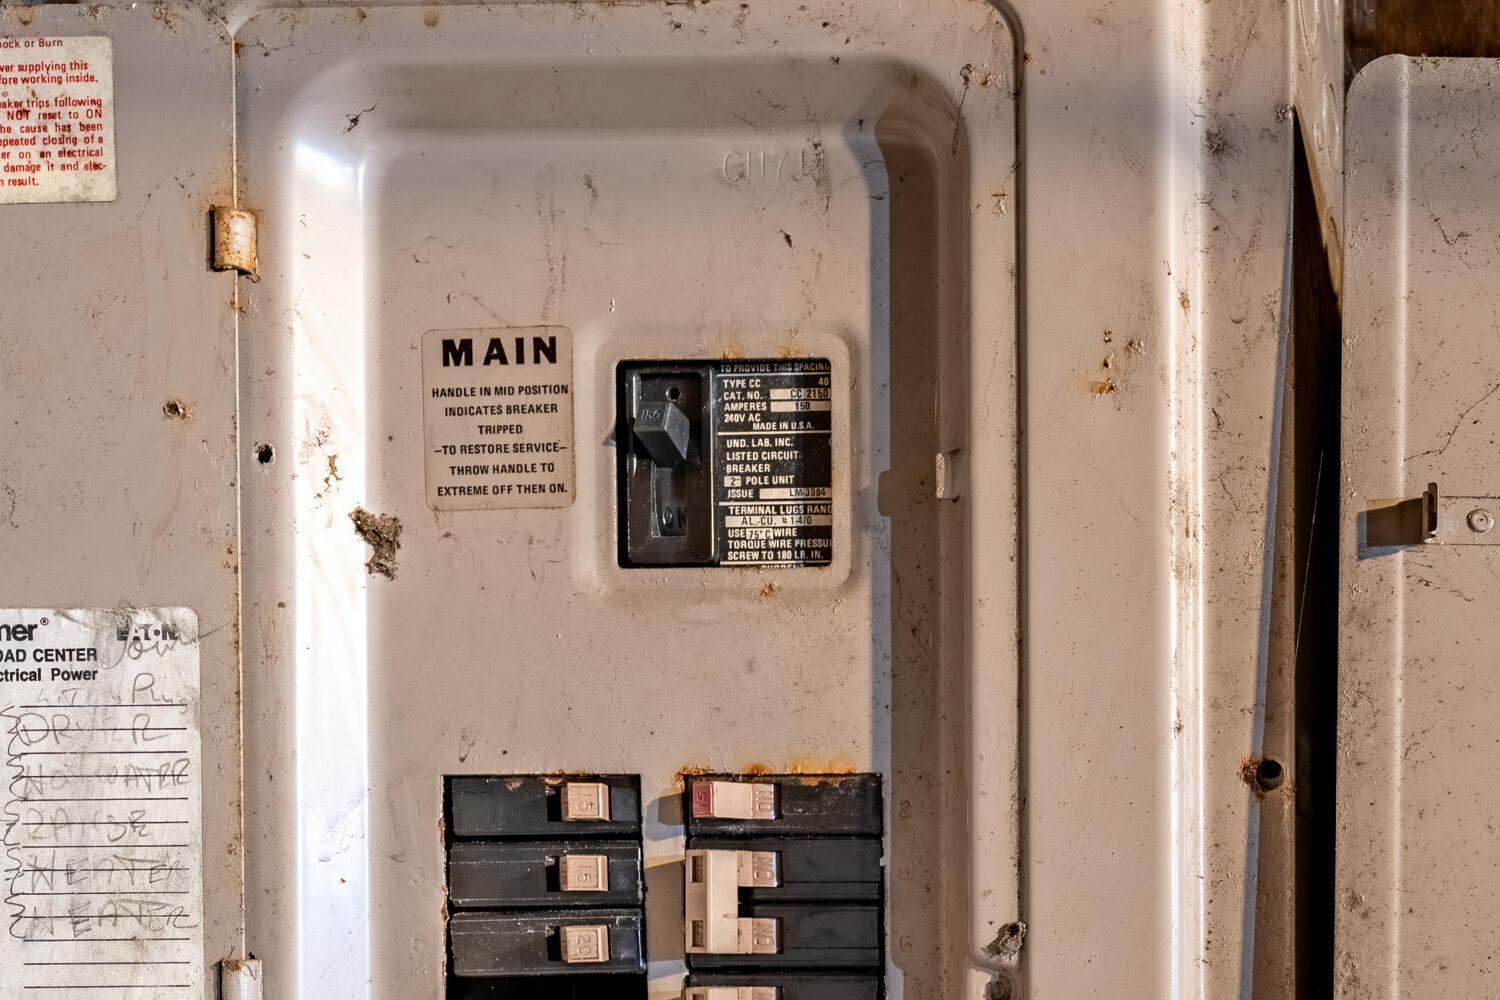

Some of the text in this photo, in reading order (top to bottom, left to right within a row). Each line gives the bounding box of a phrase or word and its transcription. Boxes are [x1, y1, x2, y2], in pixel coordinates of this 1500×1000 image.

[24, 39, 63, 48] or Burn
[18, 61, 88, 74] supplying this
[21, 73, 98, 84] working inside.
[27, 97, 102, 108] trips following
[442, 336, 557, 367] MAIN
[723, 379, 760, 388] TYPE CC
[432, 384, 568, 398] HANDLE IN MID POSITION
[724, 390, 828, 400] CAT. NO. CC 2150
[445, 404, 558, 416] INDICATES BREAKER
[724, 402, 810, 411] AMPERES 150
[478, 424, 522, 434] TRIPPED
[753, 422, 777, 430] MADE
[460, 444, 509, 454] RESTORE
[726, 451, 799, 460] LISTED CIRCUIT
[450, 463, 554, 475] THROW HANDLE TO
[726, 464, 770, 473] BREAKER
[745, 476, 770, 485] POLE
[772, 476, 794, 484] UNIT
[438, 483, 568, 496] EXTREME OFF THEN ON.
[32, 648, 97, 662] CENTER
[51, 667, 98, 681] Power
